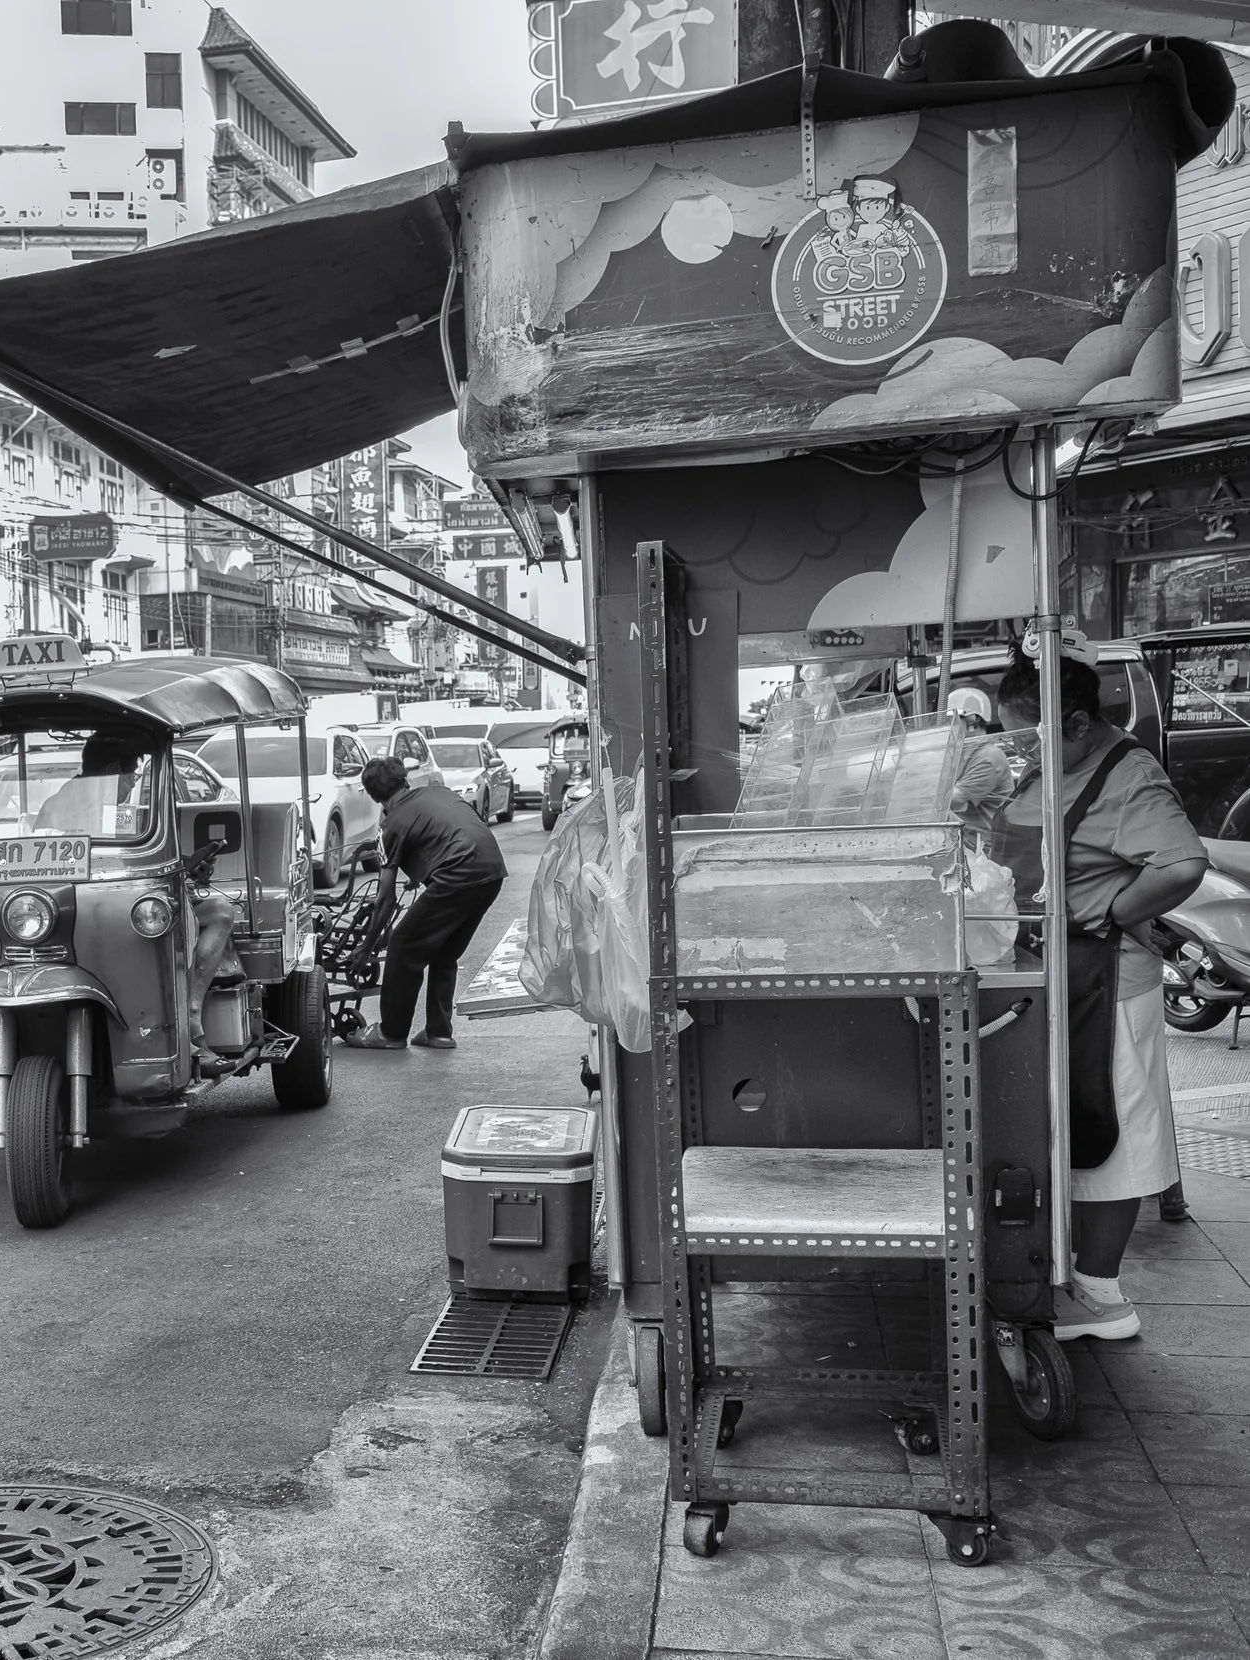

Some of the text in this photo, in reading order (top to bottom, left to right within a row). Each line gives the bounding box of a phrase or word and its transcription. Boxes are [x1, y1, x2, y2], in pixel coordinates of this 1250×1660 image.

[596, 0, 715, 93] 行
[813, 250, 905, 294] GSB
[823, 295, 901, 318] STREET
[846, 275, 927, 346] RECOMMENDED BY GSB
[835, 315, 889, 331] OOD
[1, 640, 66, 667] TAXI
[33, 840, 86, 864] 7120
